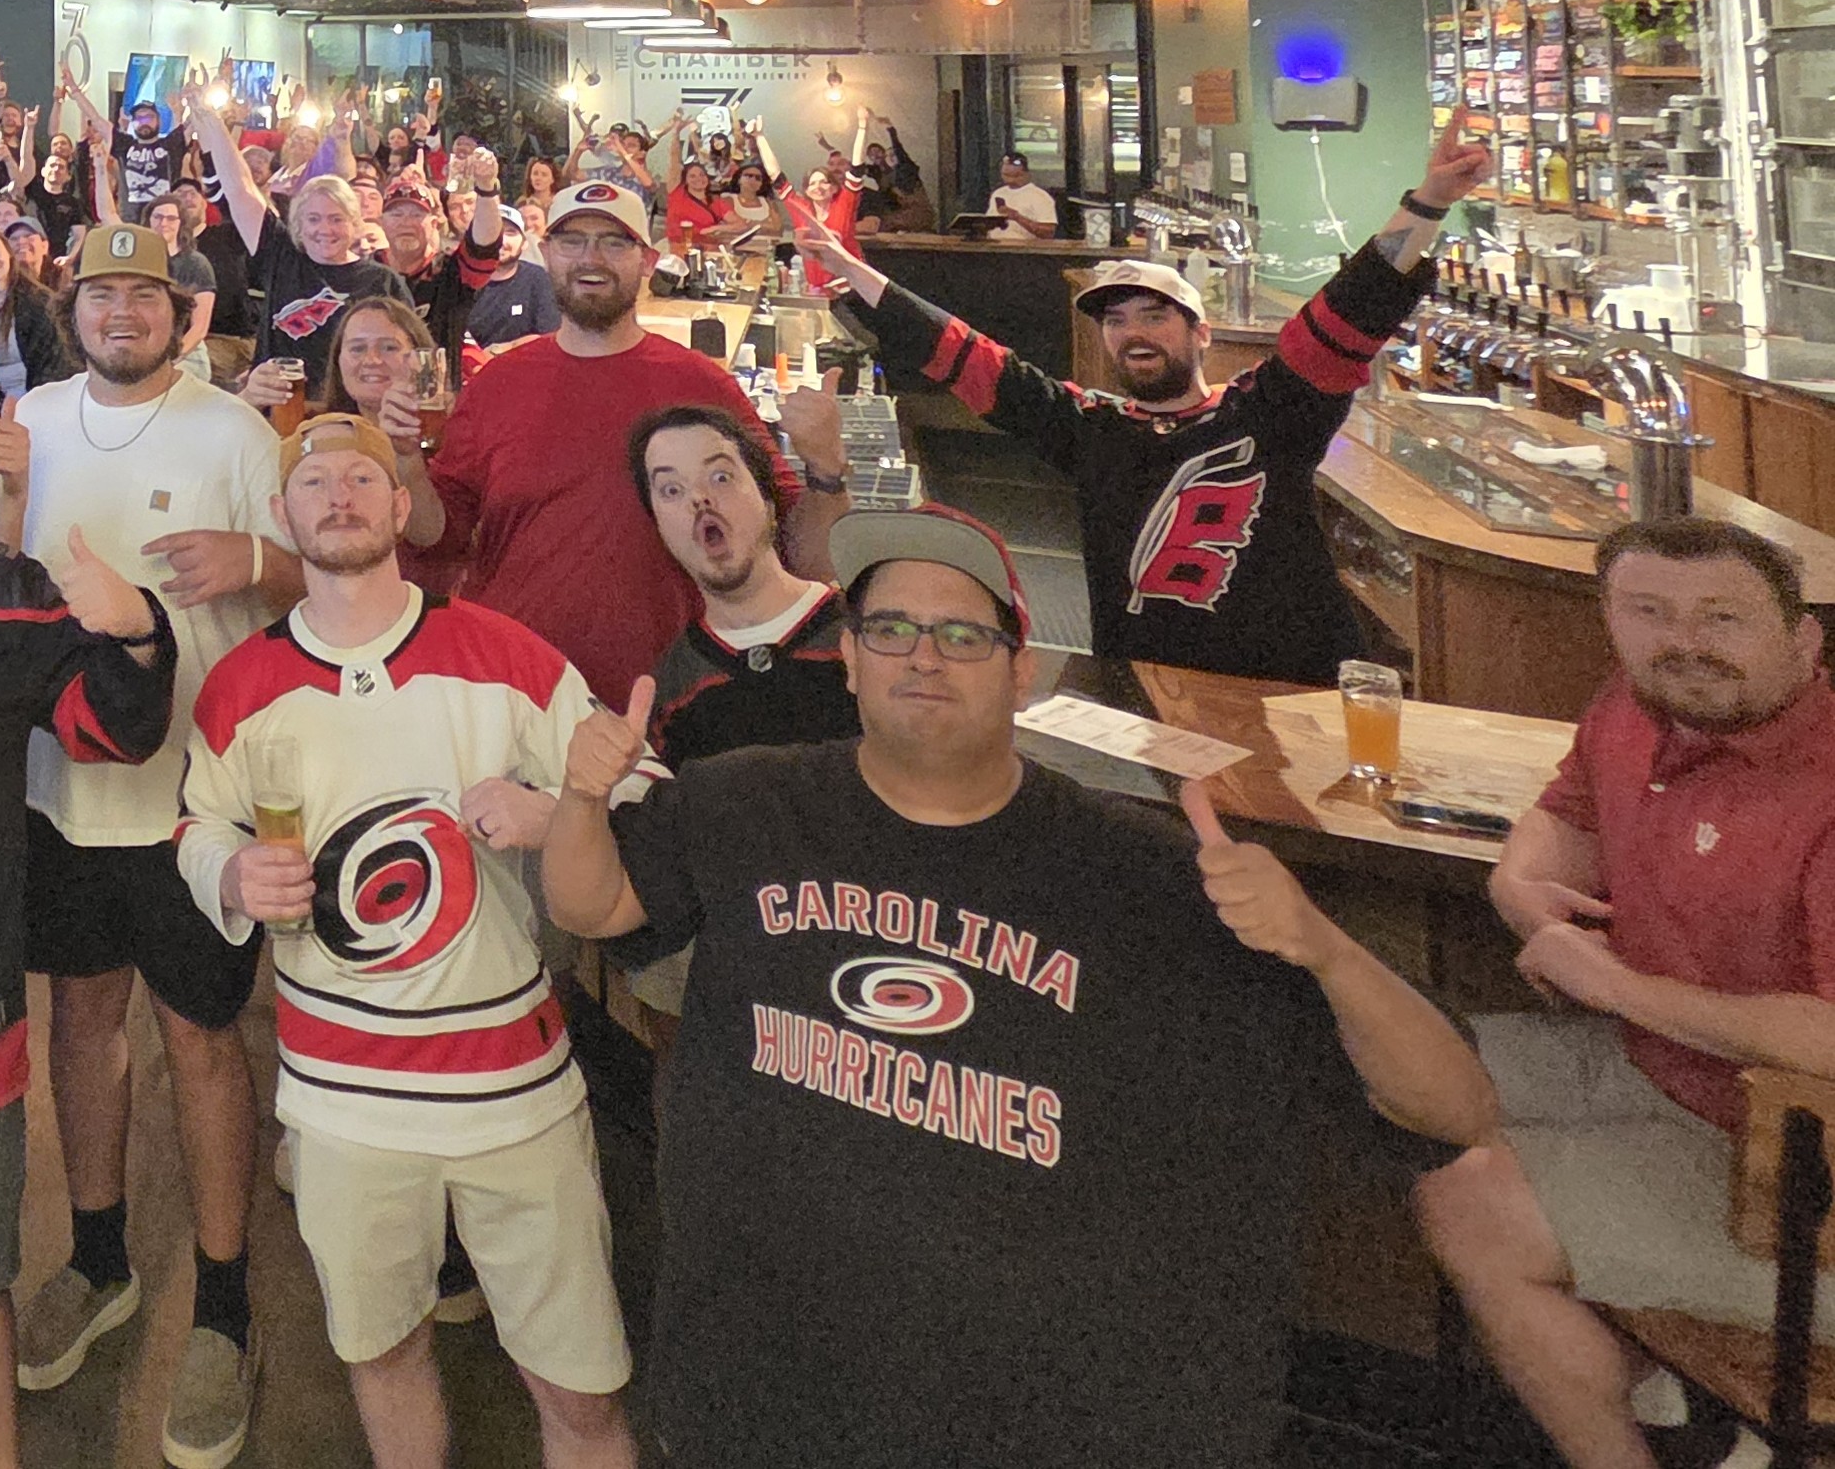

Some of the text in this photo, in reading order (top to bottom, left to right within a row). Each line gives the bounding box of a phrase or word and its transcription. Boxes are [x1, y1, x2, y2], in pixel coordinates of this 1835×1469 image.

[615, 45, 628, 70] THE
[634, 43, 812, 68] CHAMBER
[757, 881, 1080, 1014] CAROLINA
[752, 1003, 1063, 1168] HURRICANES
